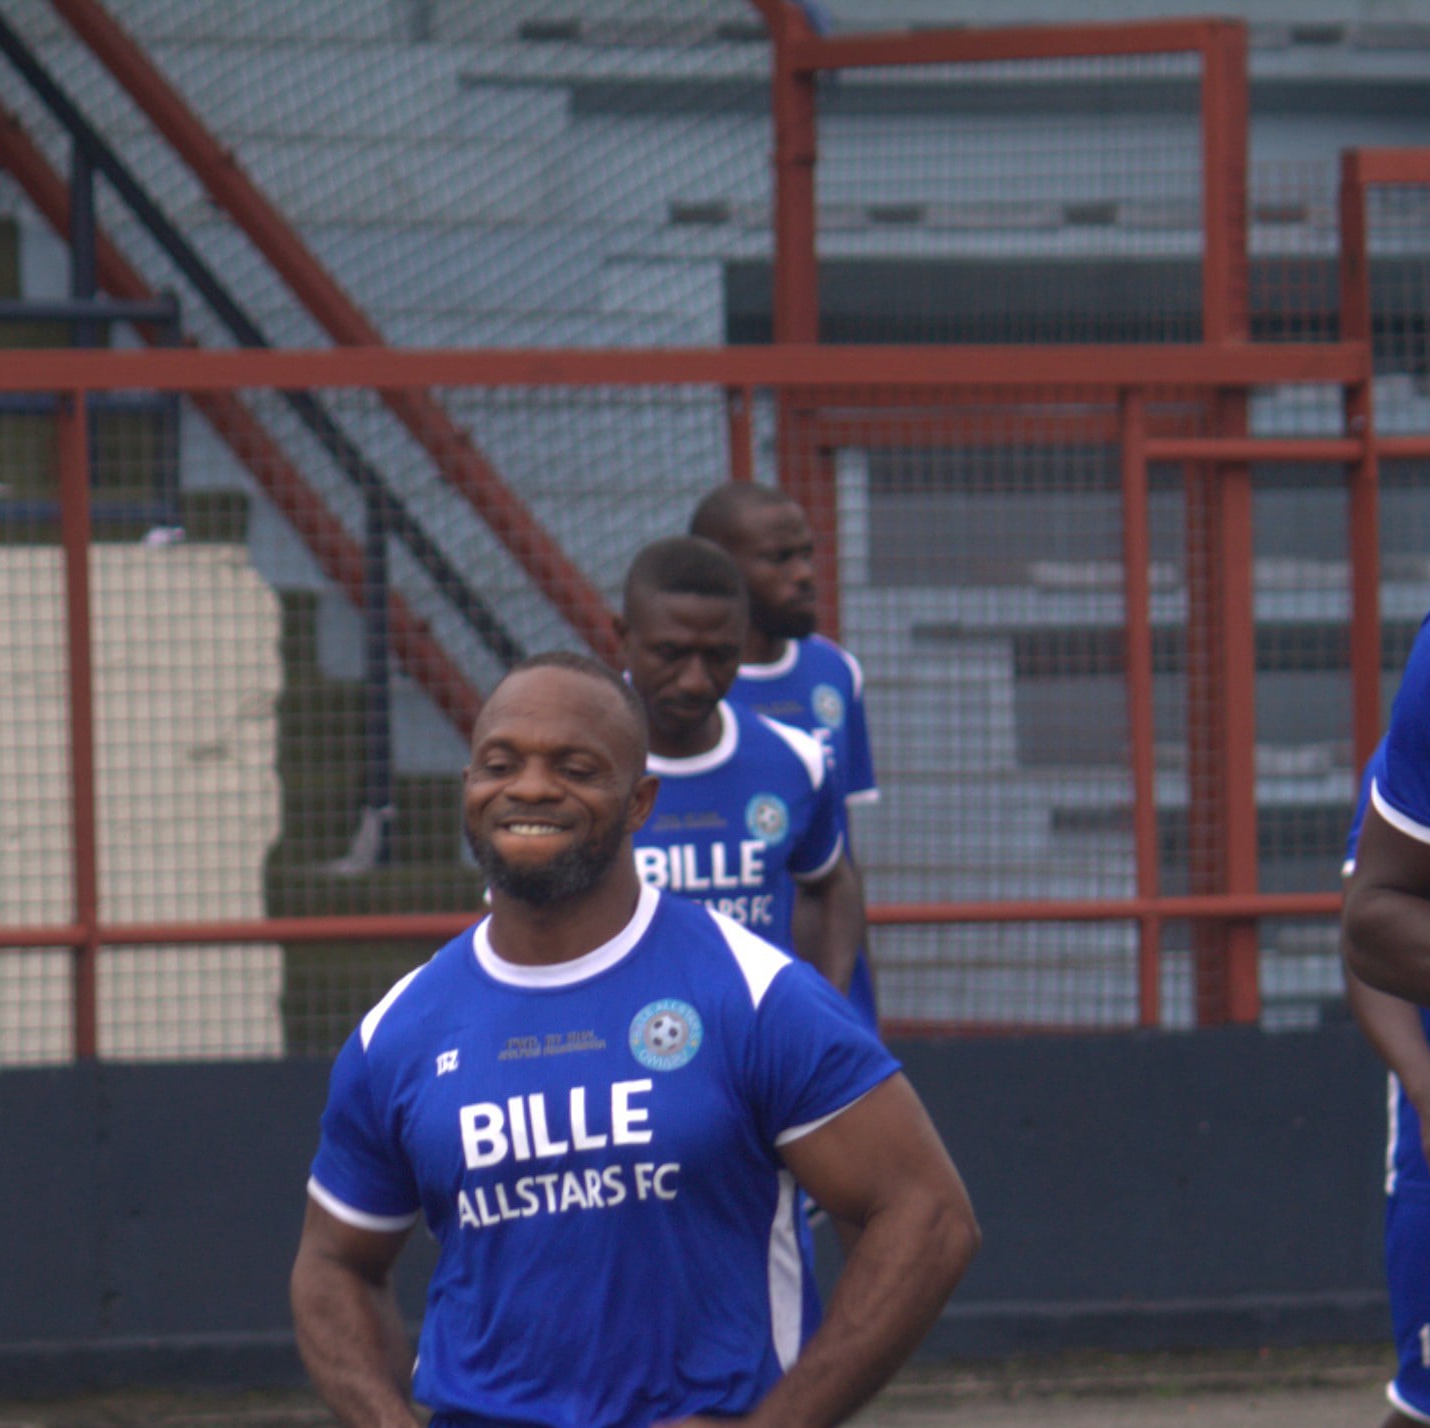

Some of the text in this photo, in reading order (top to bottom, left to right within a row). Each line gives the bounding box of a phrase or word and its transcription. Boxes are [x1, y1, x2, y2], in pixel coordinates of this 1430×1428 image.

[633, 840, 767, 890] BILLE
[459, 1079, 653, 1170] BILLE
[458, 1163, 680, 1230] ALLSTARS FC
